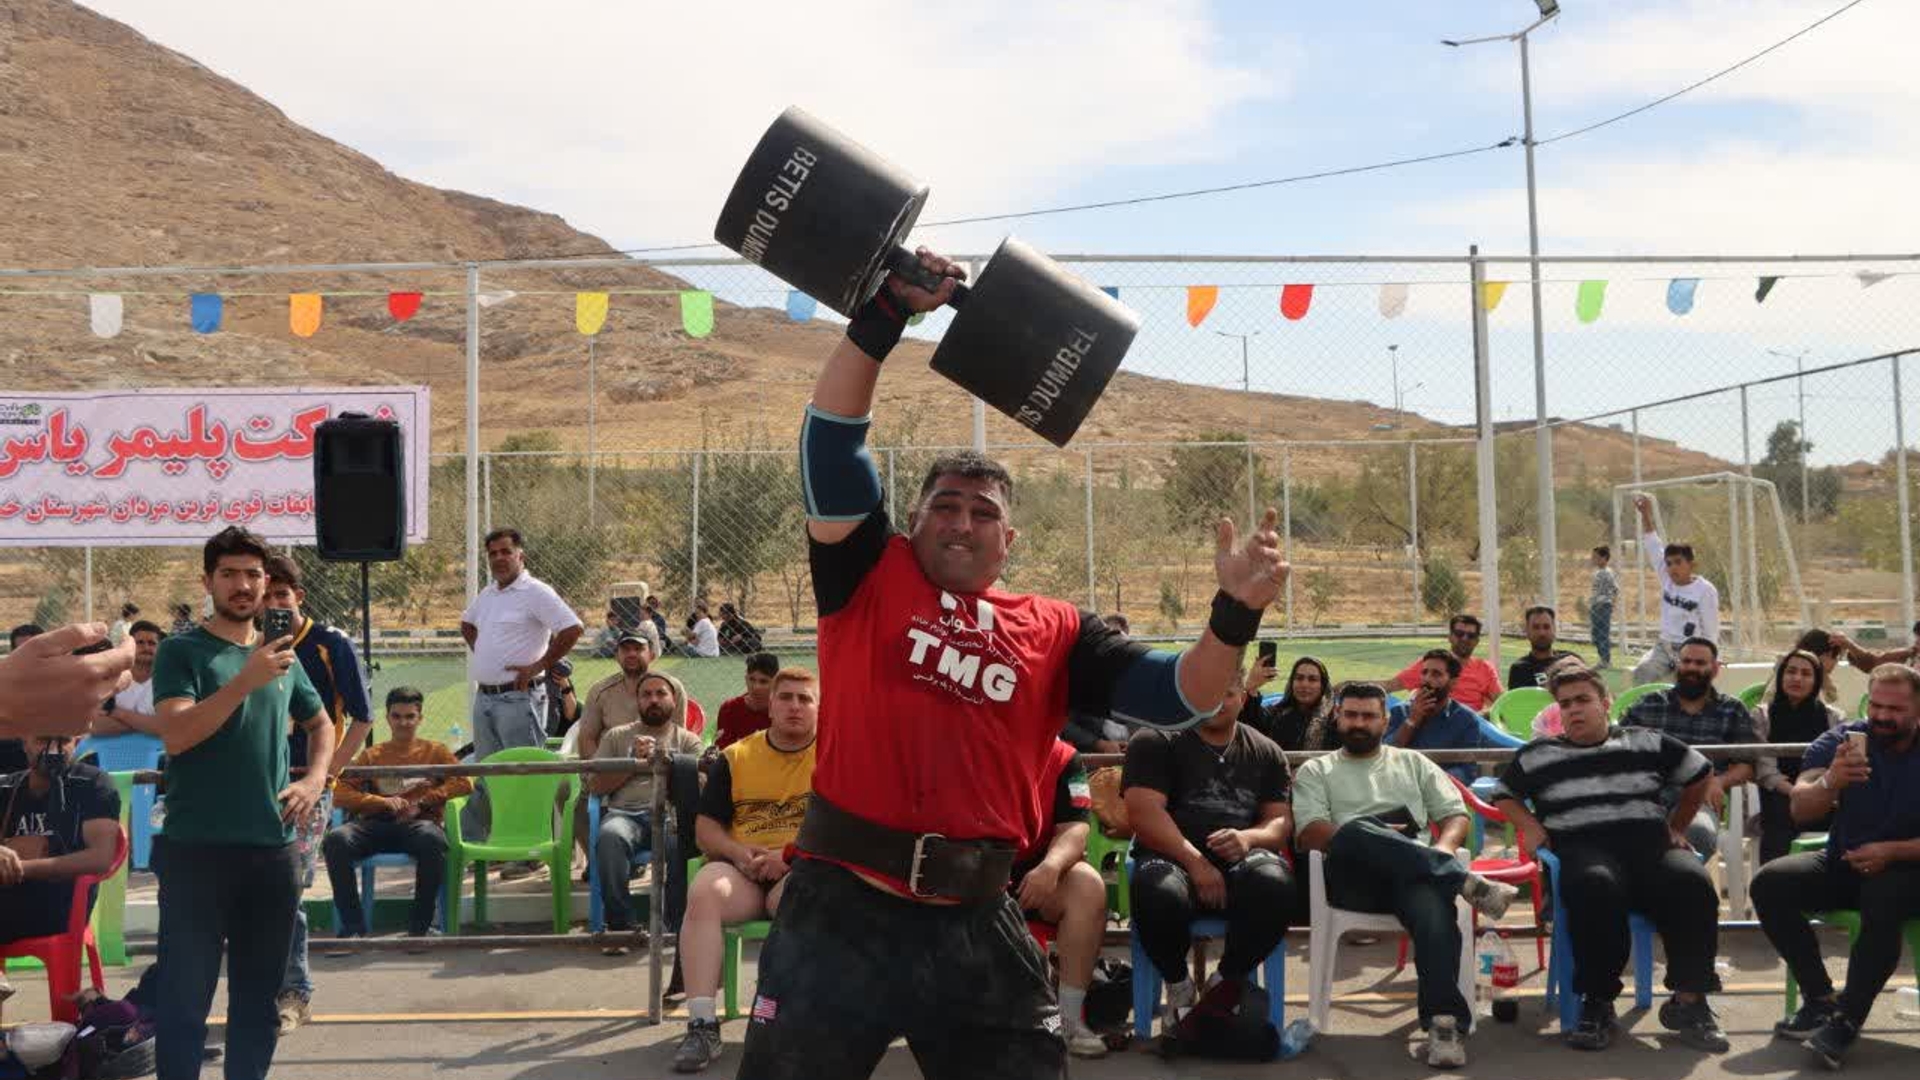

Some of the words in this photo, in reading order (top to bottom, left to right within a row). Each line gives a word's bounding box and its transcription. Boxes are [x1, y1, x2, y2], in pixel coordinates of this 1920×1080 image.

[765, 145, 817, 211] BETIS
[1028, 325, 1098, 410] DUMBEL
[93, 403, 230, 480] پلیمر
[907, 628, 1018, 703] TMG
